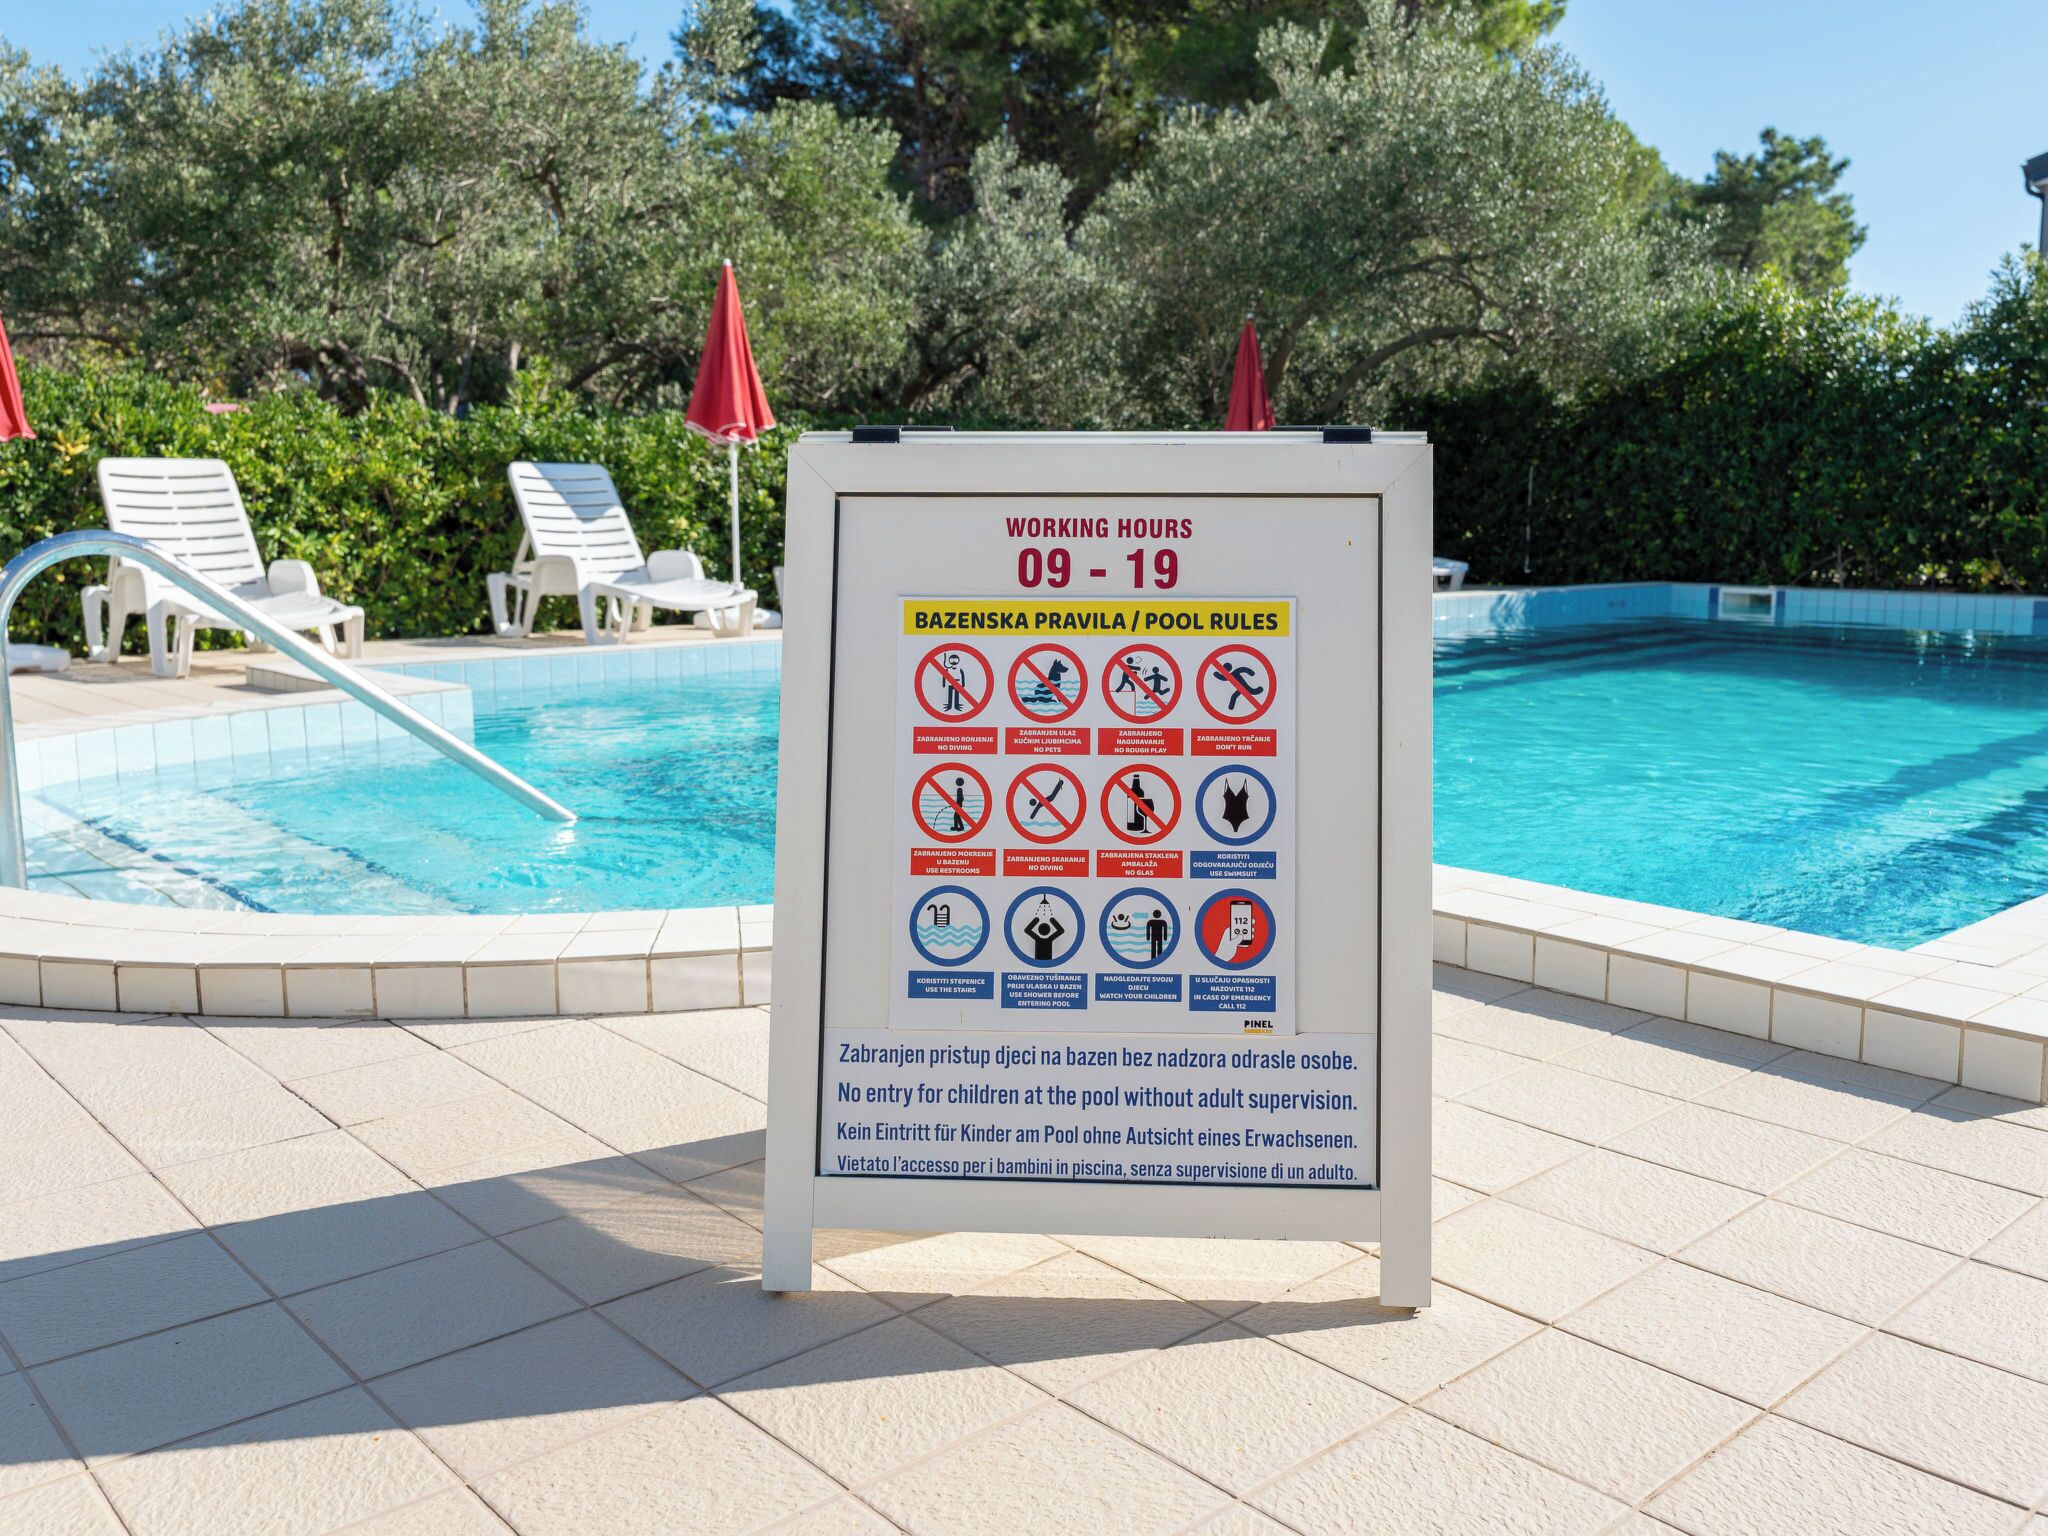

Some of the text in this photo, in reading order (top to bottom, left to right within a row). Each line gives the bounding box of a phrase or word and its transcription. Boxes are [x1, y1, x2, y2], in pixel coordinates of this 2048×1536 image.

[1006, 517, 1192, 539] WORKING HOURS
[1018, 548, 1178, 589] 09 - 19
[915, 610, 1278, 632] BAZENSKA PRAVILA / POOL RULES
[1244, 1020, 1273, 1028] PINEL
[839, 1043, 1358, 1070] Zabranjen pristup djeci na bazen bez nadzora odrasle osobe.
[838, 1083, 1358, 1113] No entry for children at the pool without adult supervision.
[838, 1122, 1358, 1148] Kein Eintritt für Kinder am Pool ohne Autsicht eines Erwachsenen.
[838, 1155, 1358, 1180] Vietato l'accesso per i bambini in piscina, senza supervisione di un adulto.
